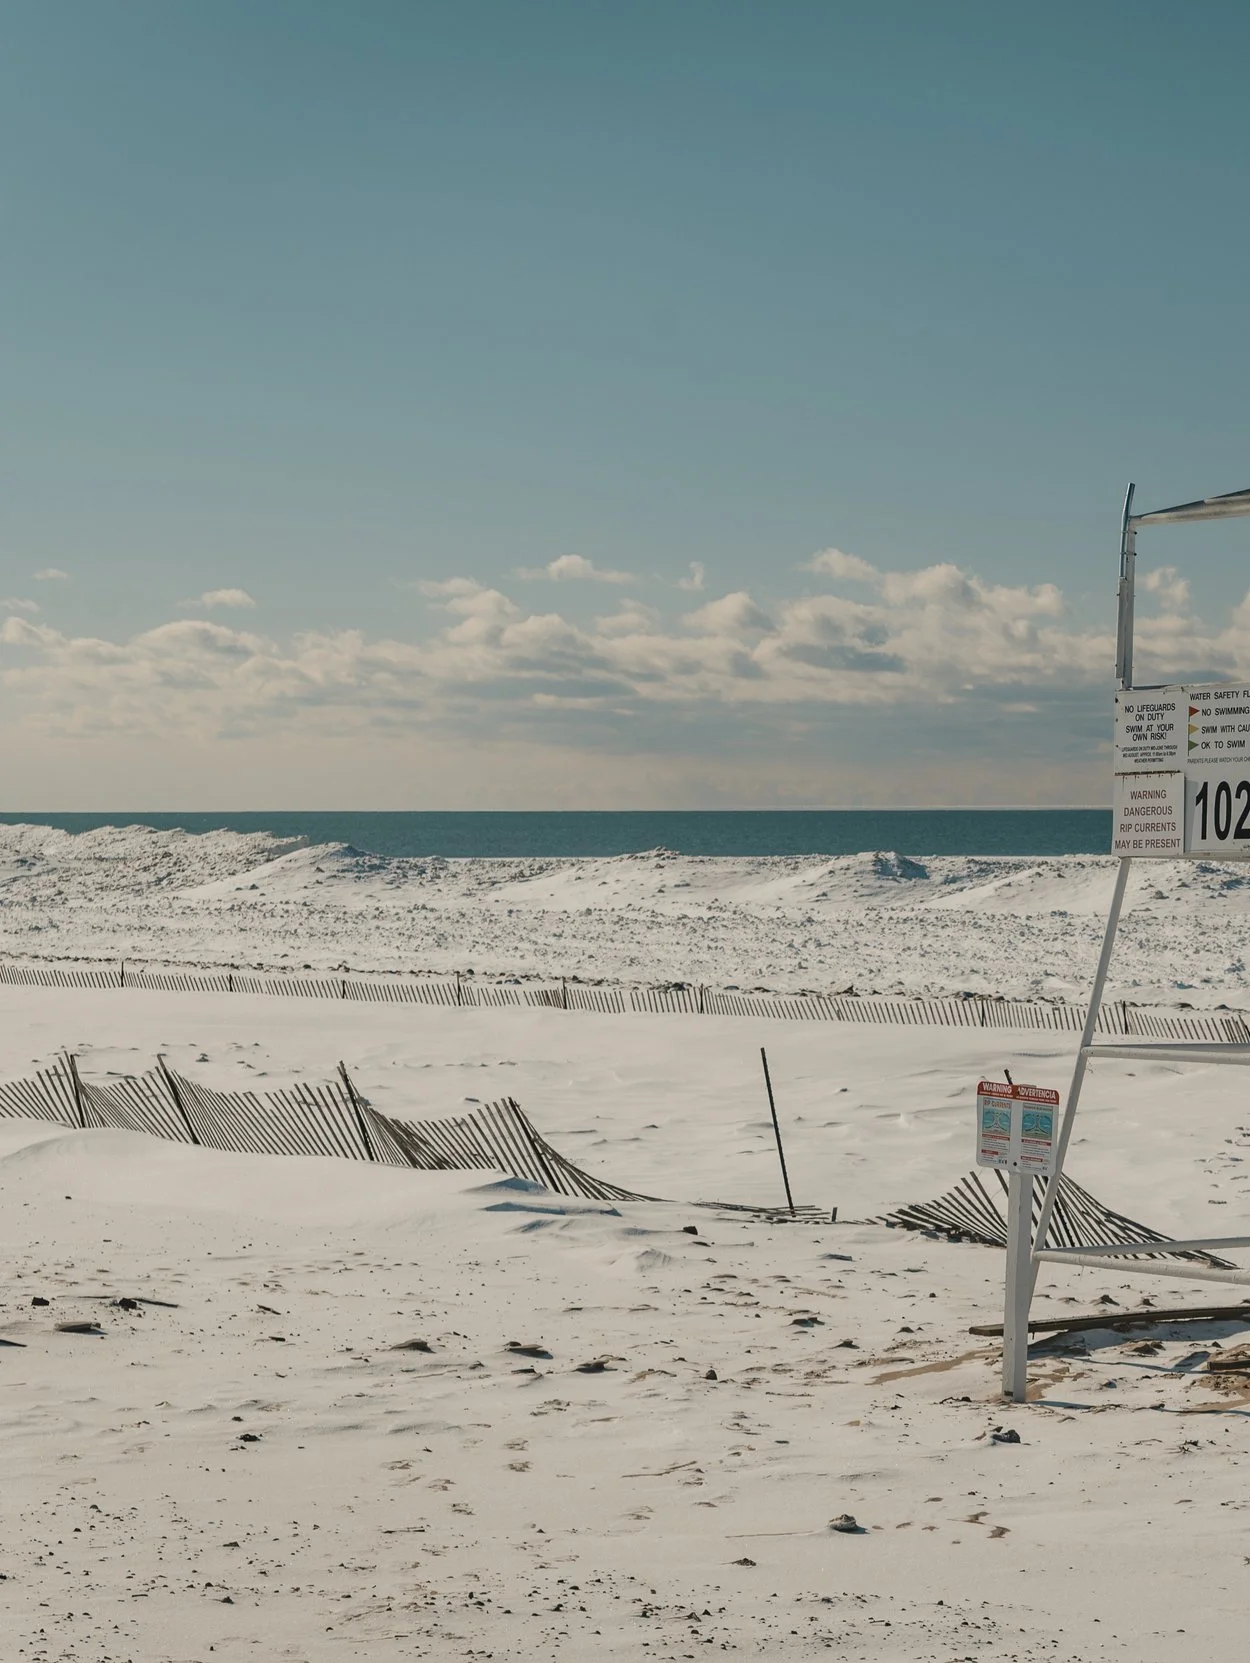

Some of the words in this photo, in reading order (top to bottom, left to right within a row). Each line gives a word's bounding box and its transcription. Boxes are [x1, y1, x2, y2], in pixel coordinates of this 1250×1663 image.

[1189, 692, 1211, 701] WATER
[1214, 690, 1240, 700] SAFETY
[1124, 705, 1135, 714] NO
[1137, 703, 1176, 713] LIFEGUARDS
[1201, 708, 1212, 717] NO
[1214, 706, 1250, 716] SWIMMING
[1135, 713, 1145, 722] ON
[1147, 712, 1165, 721] DUTY
[1125, 725, 1143, 734] SWIM
[1146, 724, 1154, 732] AT
[1157, 723, 1174, 732] YOUR
[1201, 726, 1218, 735] SWIM
[1220, 725, 1236, 733] WITH
[1132, 733, 1148, 742] OWN
[1150, 732, 1167, 741] RISK!
[1201, 741, 1211, 750] OK
[1214, 740, 1224, 749] TO
[1227, 740, 1246, 749] SWIM
[1130, 789, 1167, 800] WARNING
[1123, 806, 1173, 817] DANGEROUS
[1119, 823, 1133, 833] RIP
[1134, 822, 1177, 833] CURRENTS
[1114, 840, 1131, 849] MAY
[1132, 839, 1143, 849] BE
[1145, 838, 1181, 849] PRESENT
[982, 1082, 1012, 1094] WARNING
[1017, 1087, 1056, 1100] ADVERTENCIA
